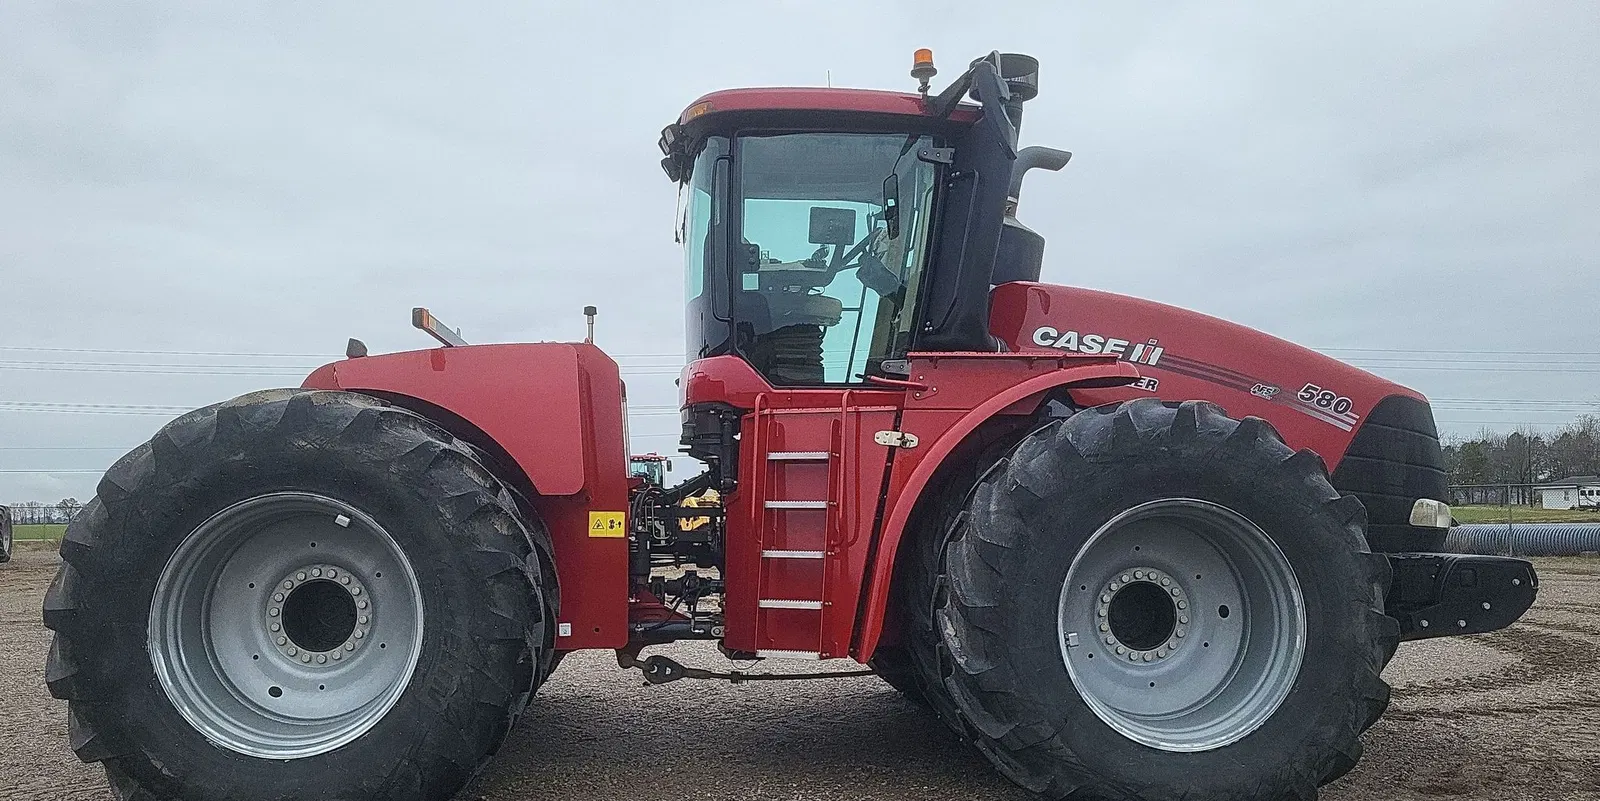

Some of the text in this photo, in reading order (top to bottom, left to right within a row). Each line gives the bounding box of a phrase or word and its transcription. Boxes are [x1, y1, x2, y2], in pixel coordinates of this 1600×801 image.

[1032, 326, 1130, 358] CASE
[1126, 376, 1159, 392] ER
[1297, 382, 1353, 415] 580
